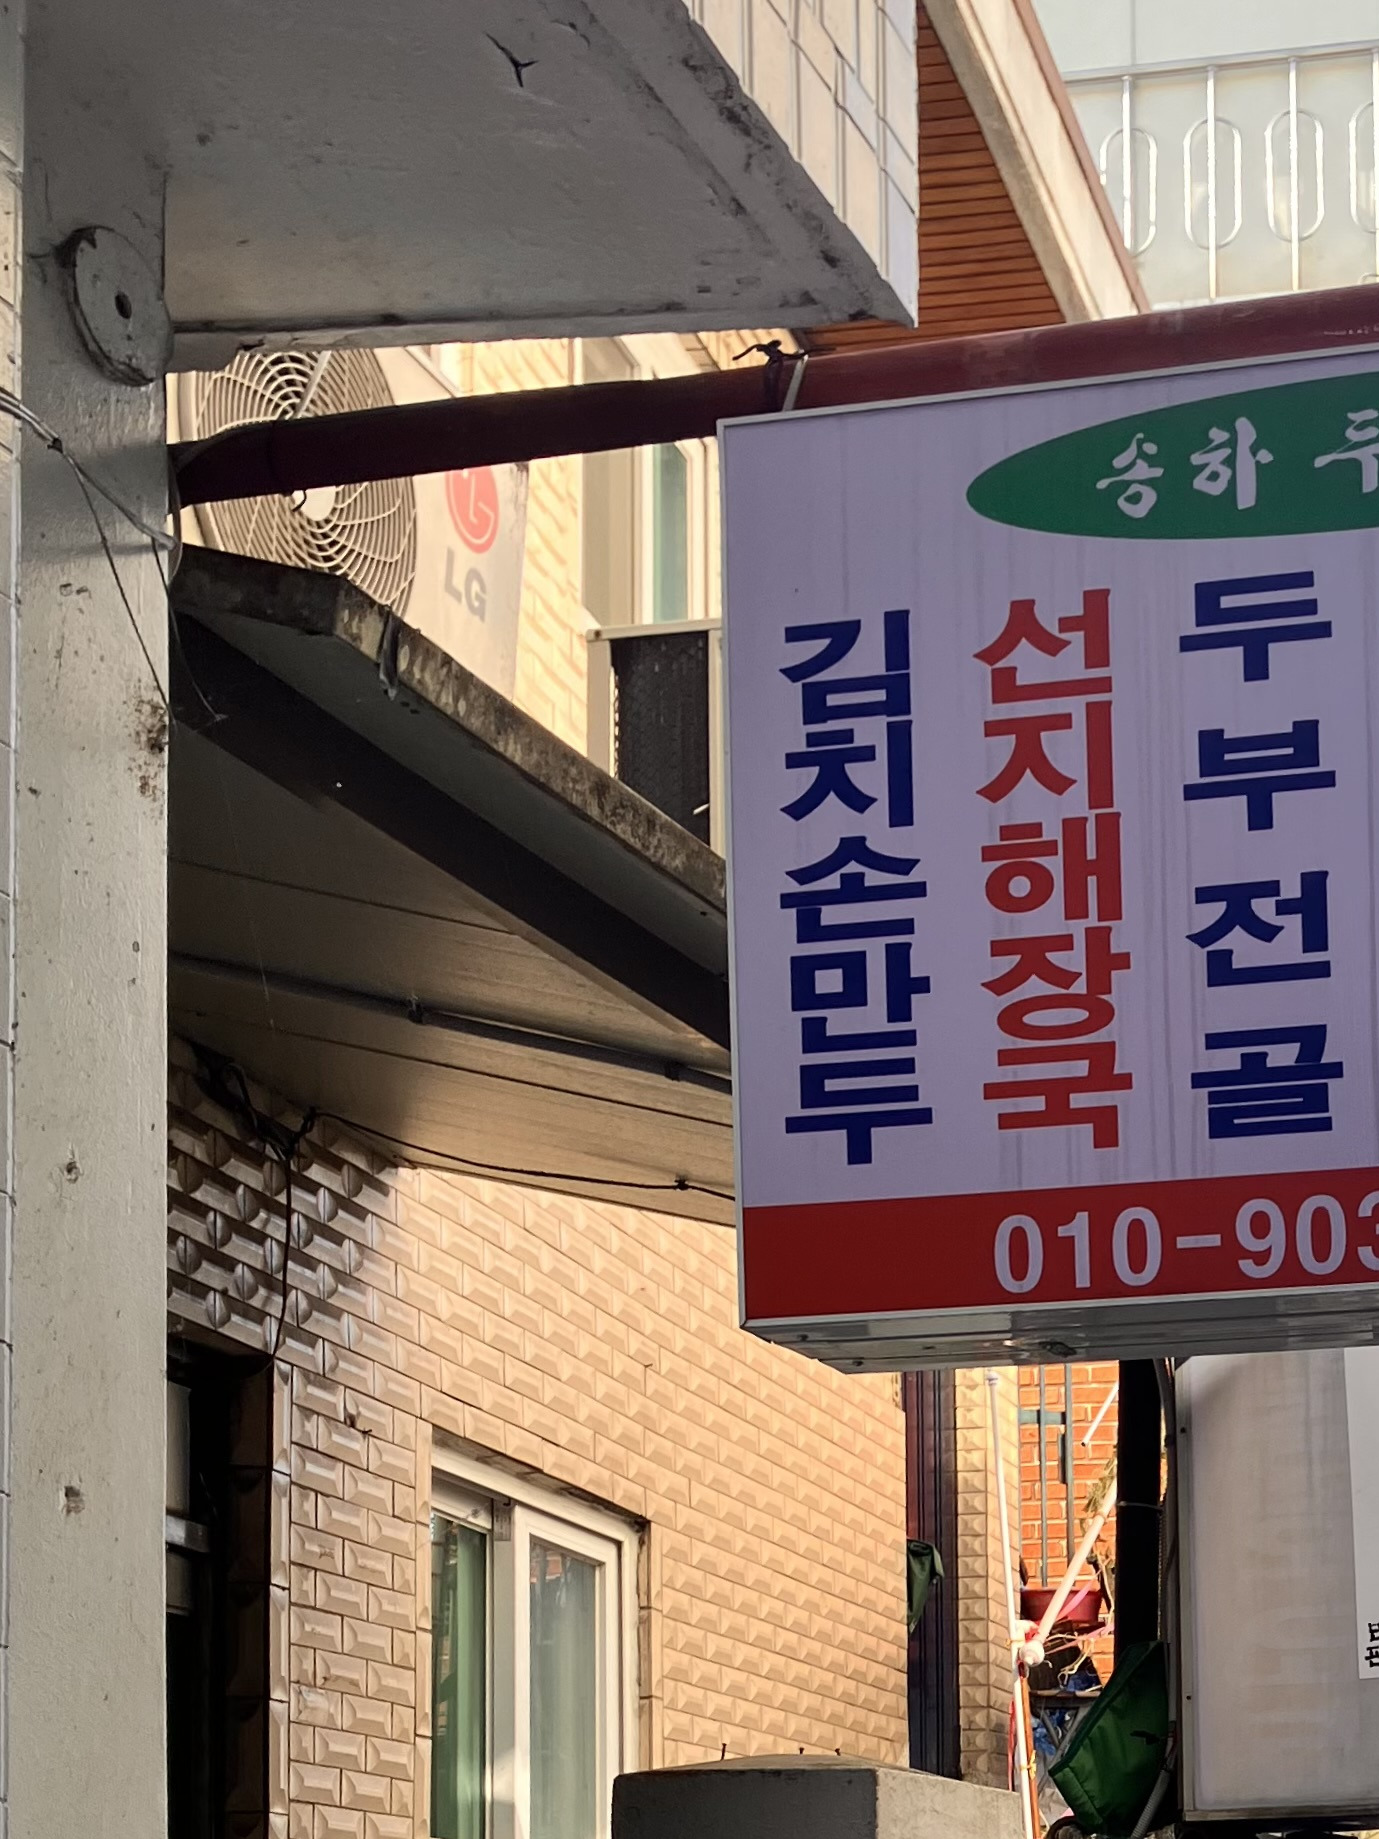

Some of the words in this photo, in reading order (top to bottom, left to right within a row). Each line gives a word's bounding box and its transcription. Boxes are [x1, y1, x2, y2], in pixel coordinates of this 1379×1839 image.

[444, 548, 488, 622] LG
[1095, 420, 1274, 518] 송하
[780, 610, 932, 1165] 김치손만두
[974, 588, 1132, 1148] 선지해장국
[1180, 571, 1343, 1139] 두부전골
